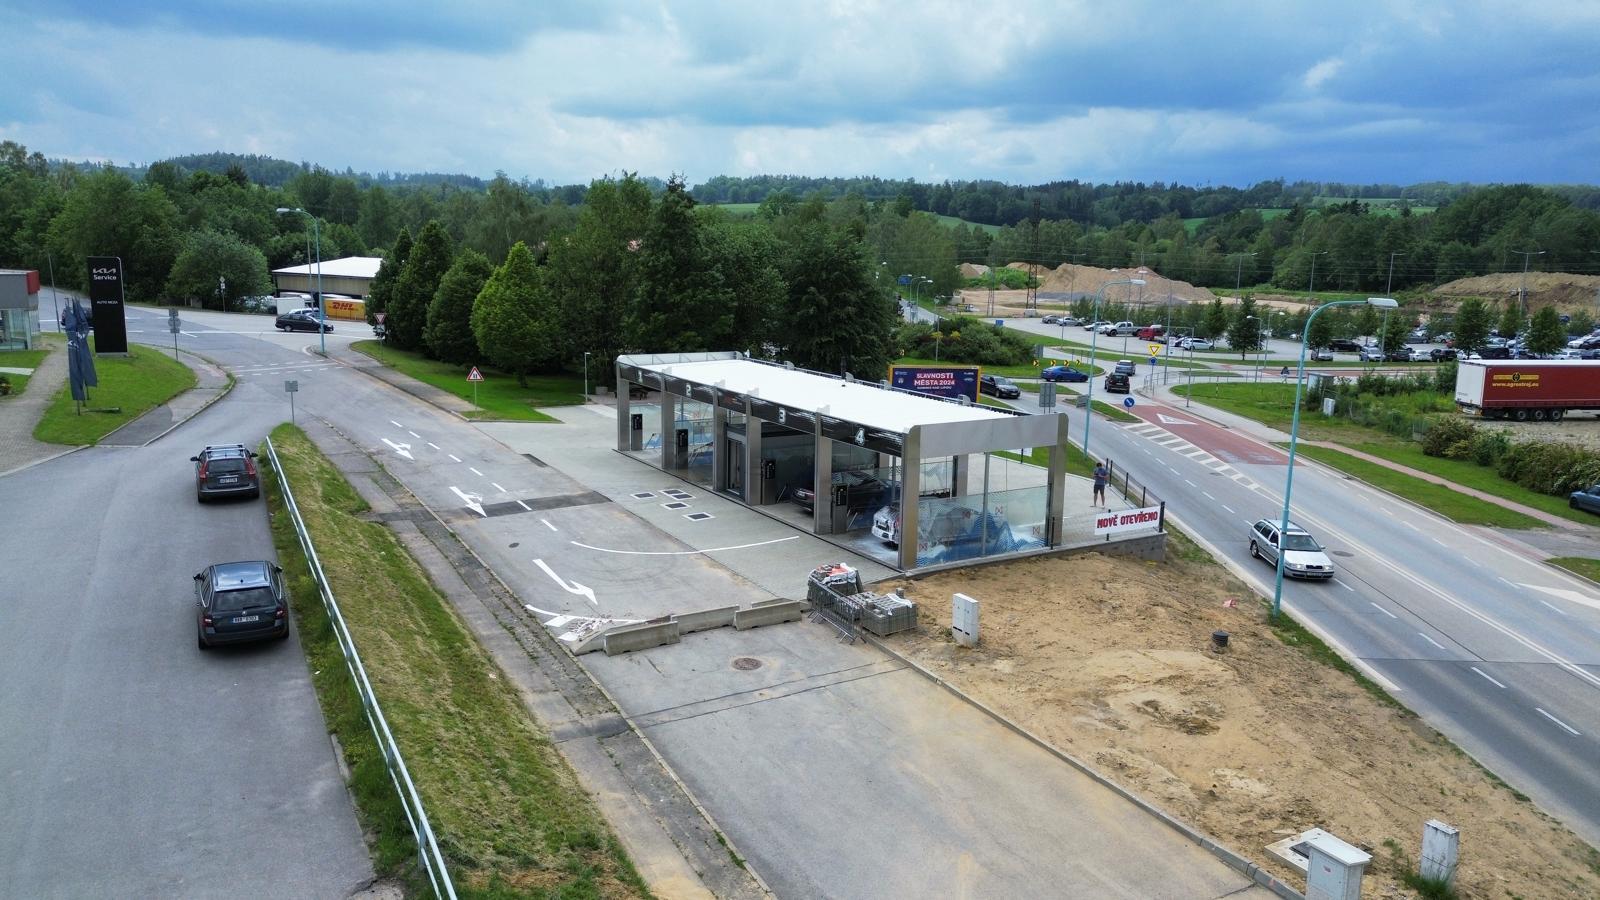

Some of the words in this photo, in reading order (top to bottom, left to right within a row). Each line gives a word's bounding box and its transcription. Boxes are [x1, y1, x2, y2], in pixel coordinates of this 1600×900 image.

[638, 369, 643, 383] 1
[685, 383, 692, 397] 2
[779, 407, 786, 424] 3
[855, 427, 865, 446] 4
[1097, 514, 1118, 528] NOVĚ
[1120, 511, 1158, 526] OTEVŘENO
